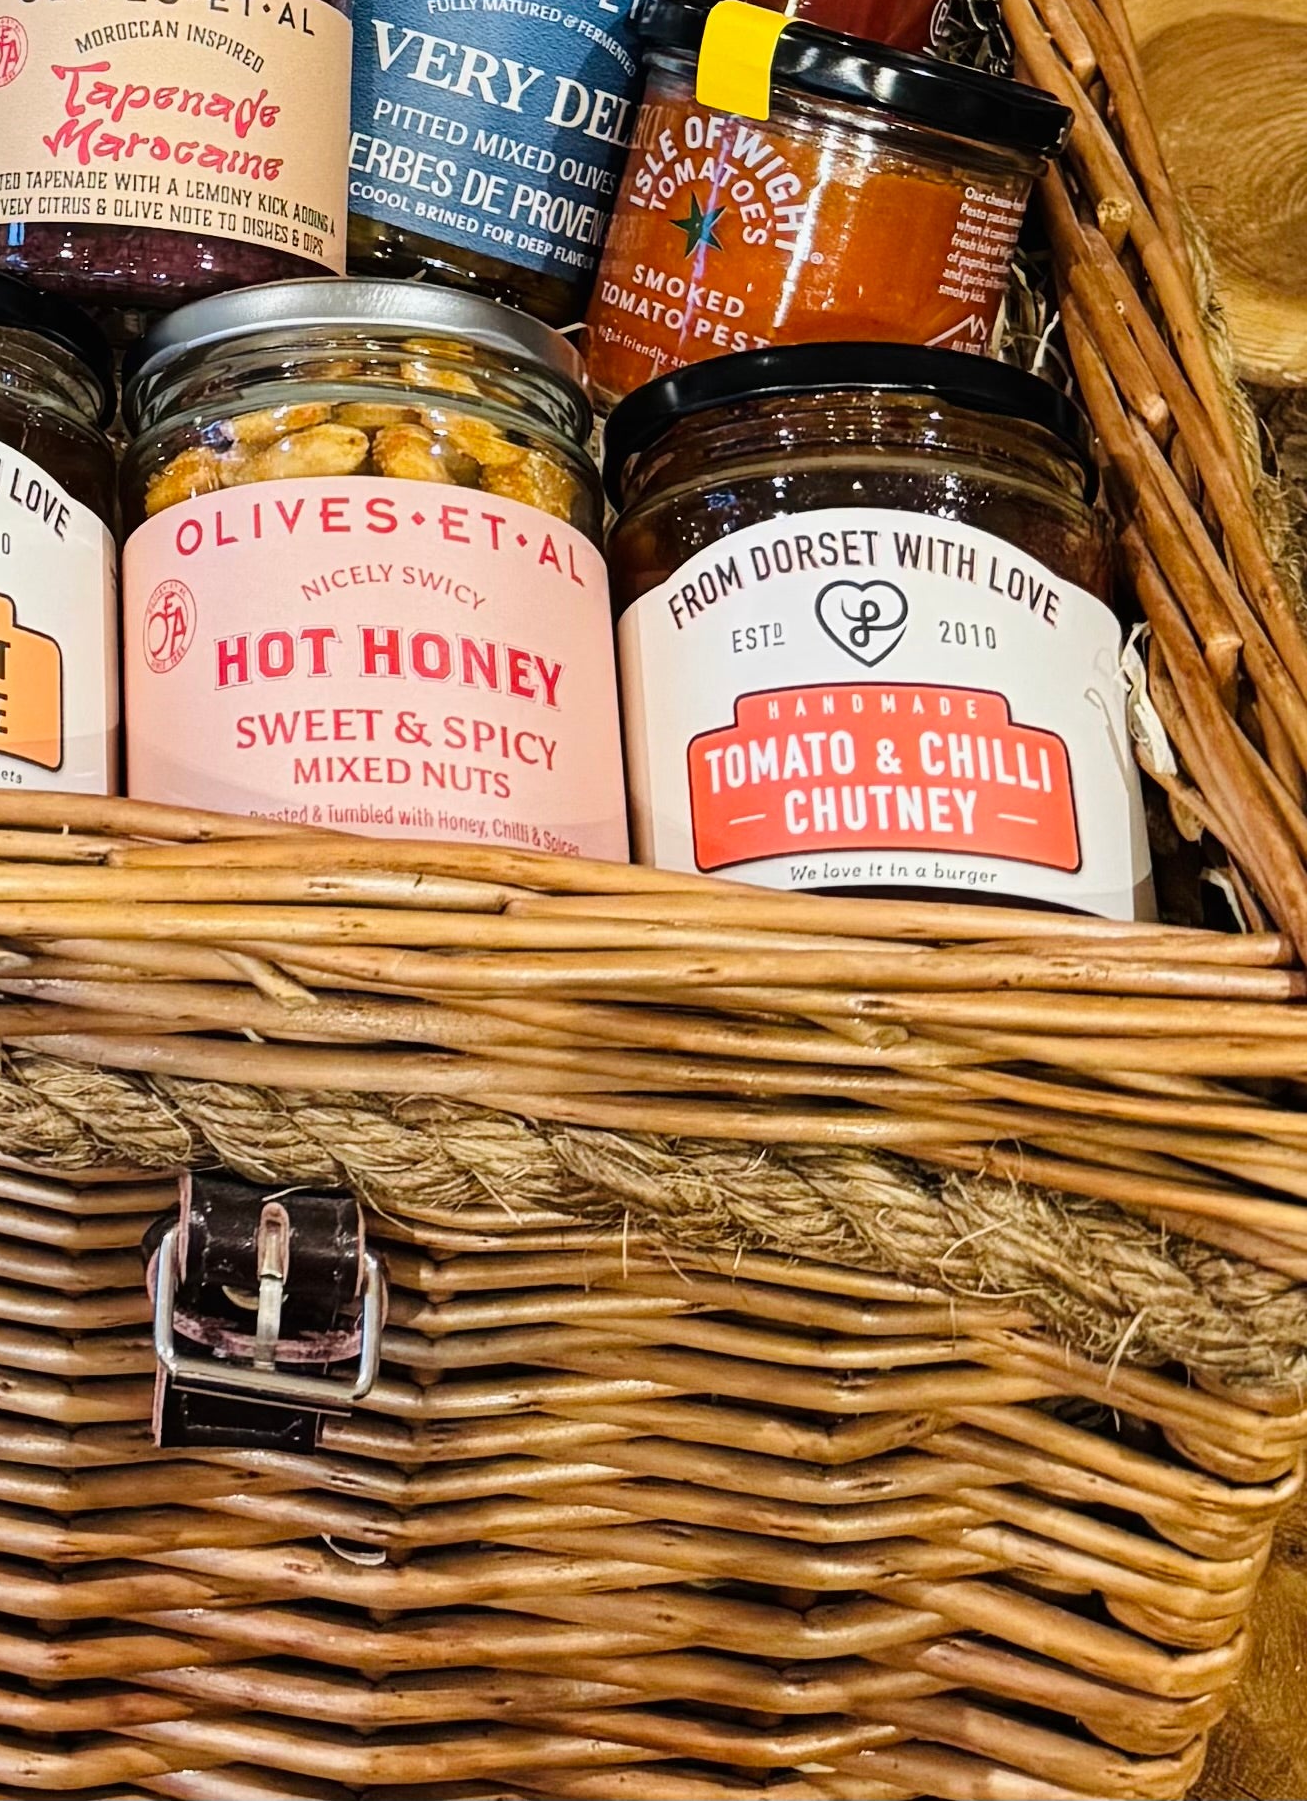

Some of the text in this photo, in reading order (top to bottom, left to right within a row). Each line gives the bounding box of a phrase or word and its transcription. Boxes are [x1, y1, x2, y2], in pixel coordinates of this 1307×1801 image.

[75, 20, 265, 75] MOROCCAN INSPIRED
[370, 18, 545, 114] VERY
[50, 61, 281, 139] Tapenade
[42, 118, 284, 182] Marocaine
[373, 98, 617, 196] PITTED MIXED OLIVES
[601, 280, 685, 330] TOMATO
[631, 262, 747, 319] SMOKED
[300, 563, 488, 612] NICELY SWICY
[667, 529, 1063, 632] FROM DORSET WITH LOVE
[938, 619, 998, 650] 2010
[212, 624, 566, 713] HOT HONEY
[767, 694, 979, 720] HANDMADE
[235, 708, 558, 772] SWEET & SPICY
[703, 730, 1053, 795] TOMATO & CHILLI
[293, 756, 513, 800] MIXED NUTS
[783, 786, 979, 837] CHUTNEY
[789, 862, 998, 886] We love it in a burger
